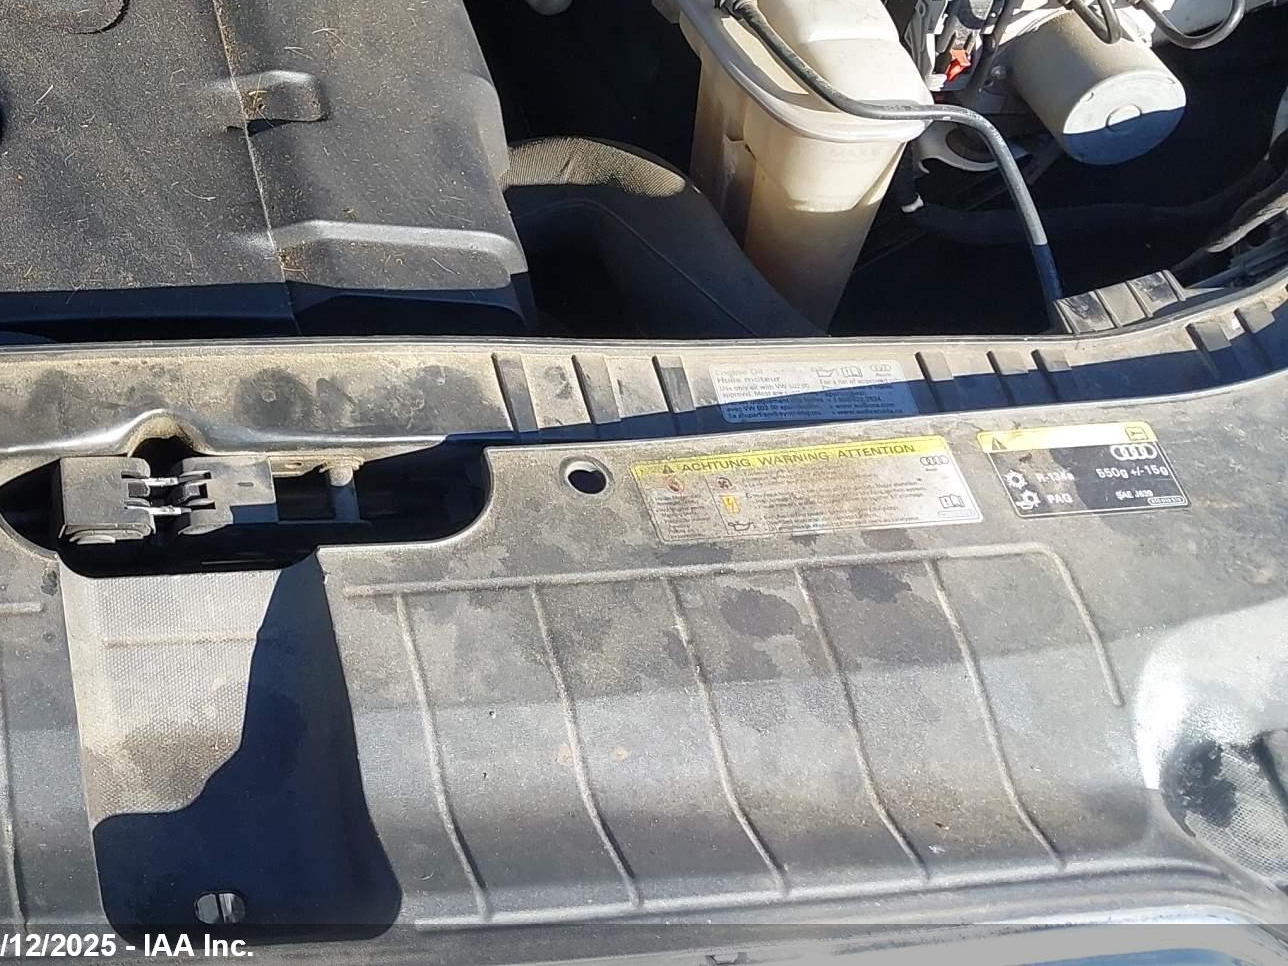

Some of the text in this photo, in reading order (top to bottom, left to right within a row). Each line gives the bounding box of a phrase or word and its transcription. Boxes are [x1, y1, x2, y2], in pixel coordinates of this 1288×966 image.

[681, 443, 916, 473] ACHTUNG WARNING ATTENTION
[1046, 493, 1073, 504] PAG
